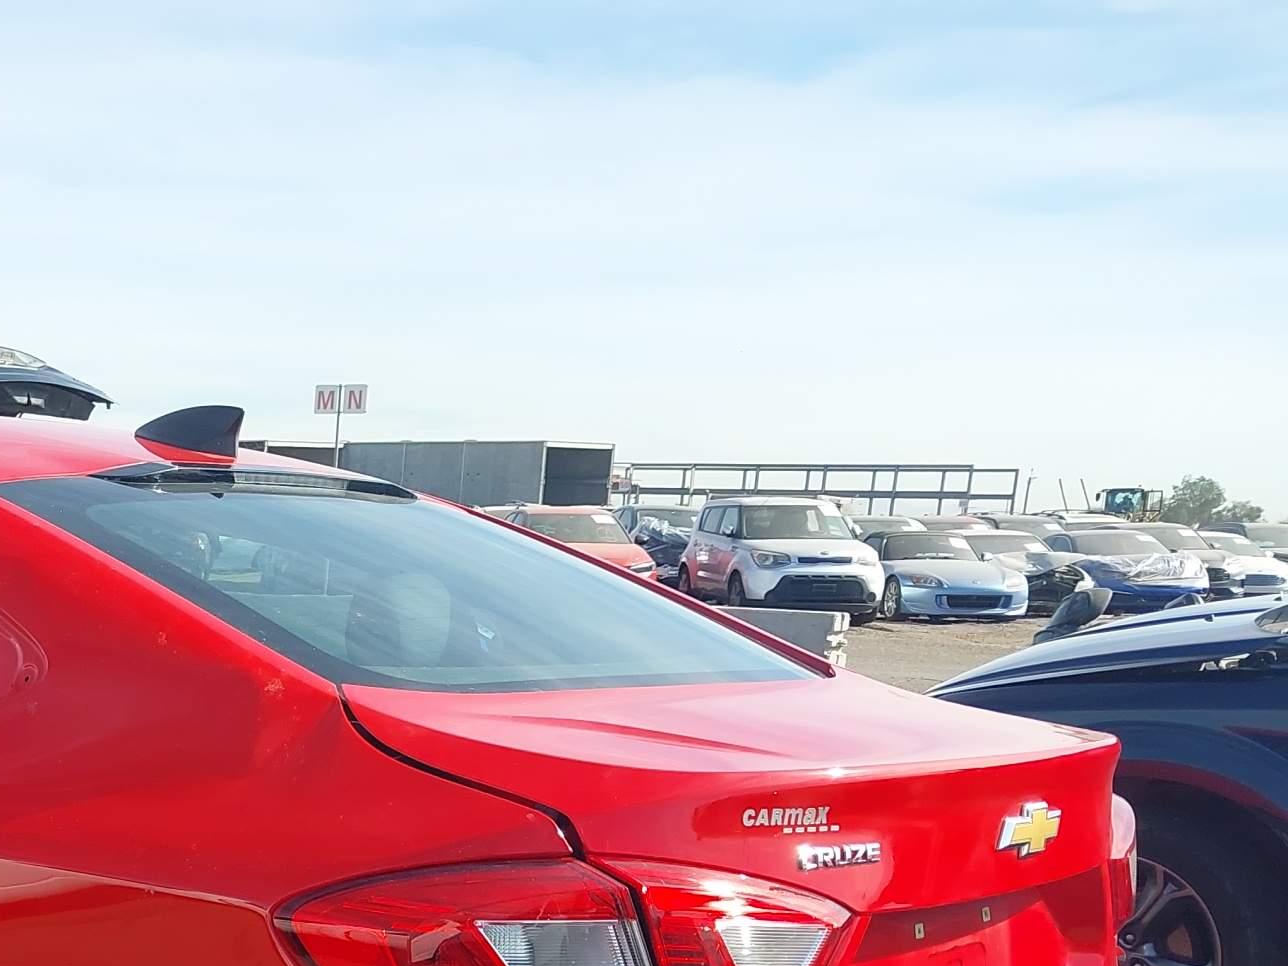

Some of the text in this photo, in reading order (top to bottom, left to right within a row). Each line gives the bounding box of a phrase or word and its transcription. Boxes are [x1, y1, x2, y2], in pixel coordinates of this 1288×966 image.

[317, 390, 335, 410] M
[348, 390, 363, 410] N
[796, 842, 881, 871] CRUZE
